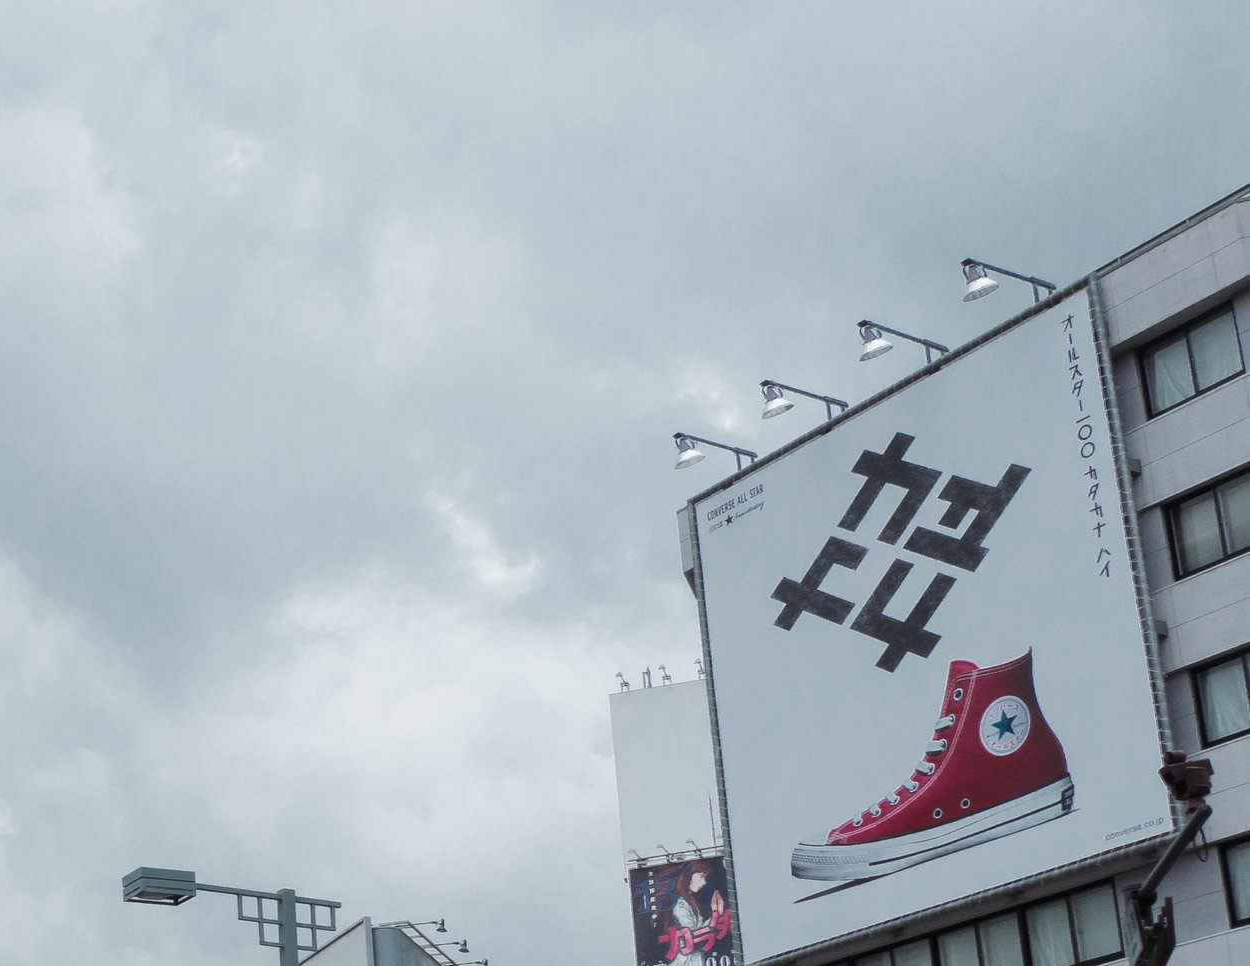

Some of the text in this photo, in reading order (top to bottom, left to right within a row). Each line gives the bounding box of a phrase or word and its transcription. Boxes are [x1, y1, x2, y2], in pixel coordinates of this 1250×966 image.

[707, 483, 764, 521] CONVERSE ALL STAR
[1083, 465, 1107, 538] カタカナ
[1105, 817, 1164, 841] converse.co.jp
